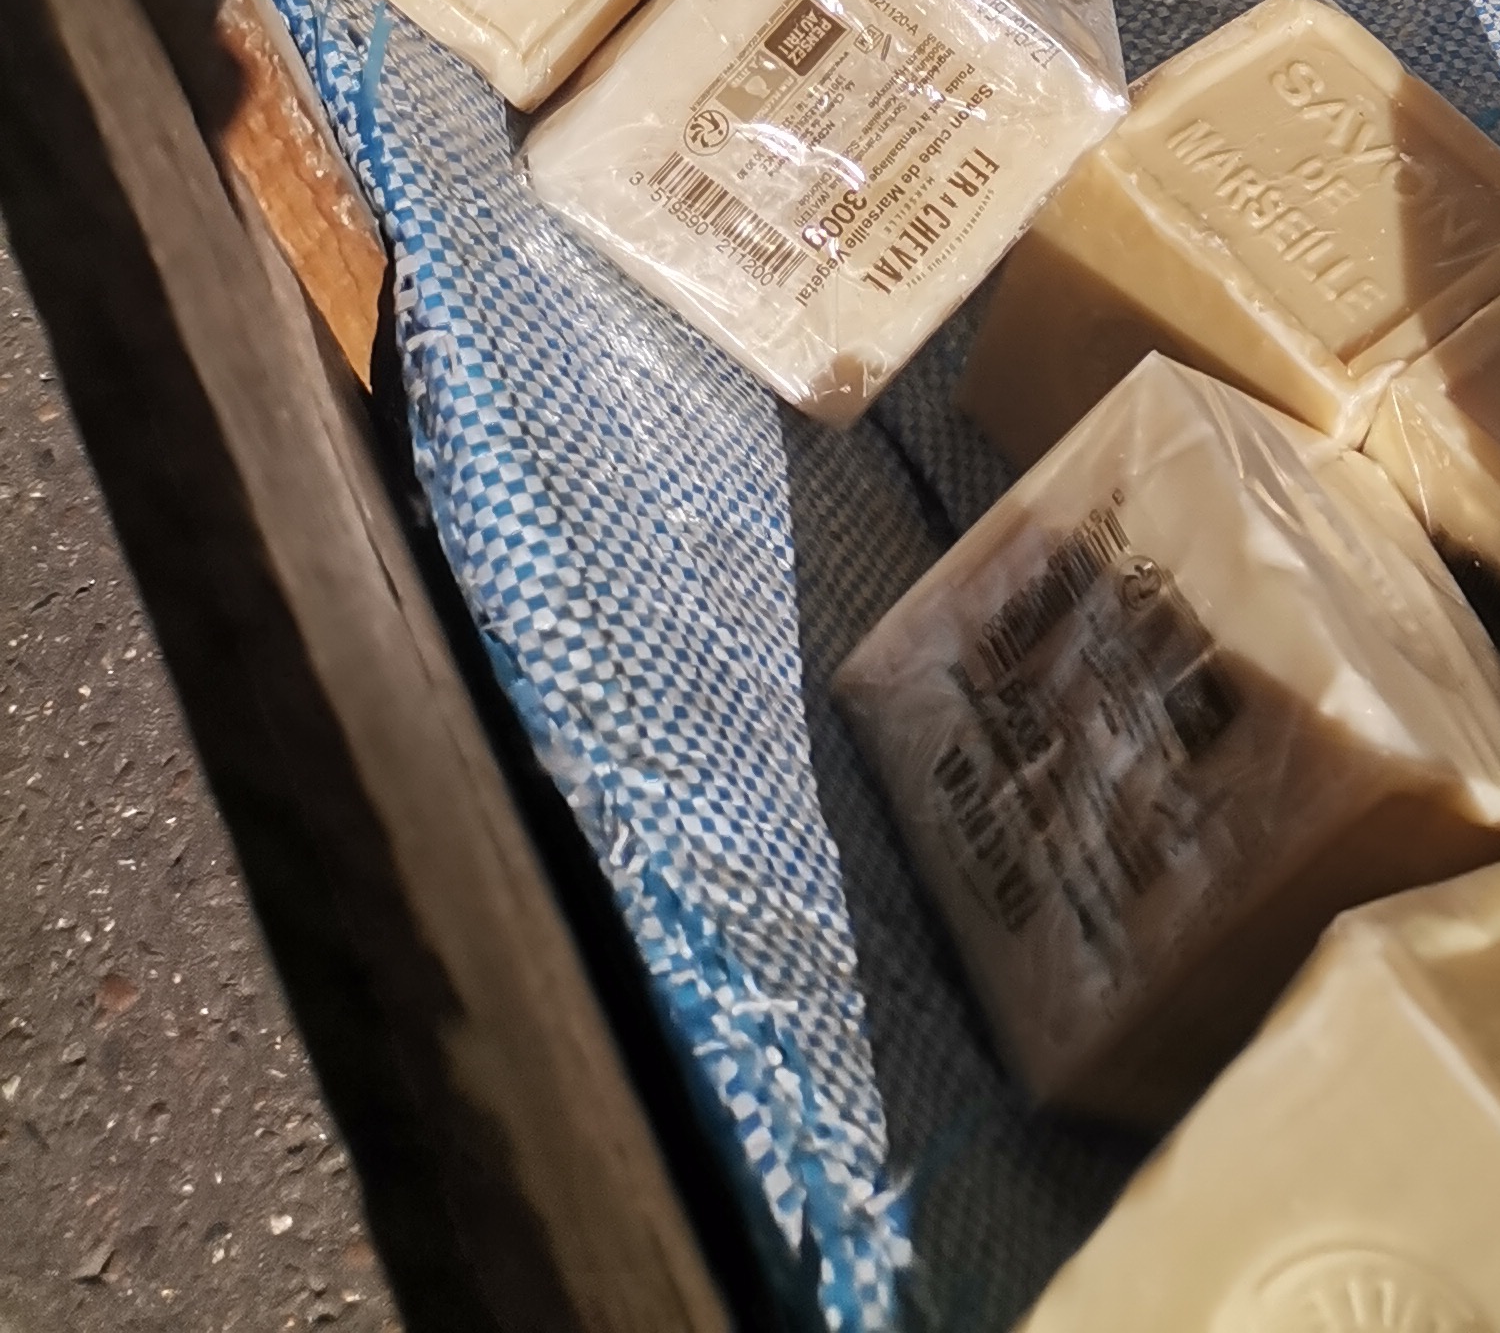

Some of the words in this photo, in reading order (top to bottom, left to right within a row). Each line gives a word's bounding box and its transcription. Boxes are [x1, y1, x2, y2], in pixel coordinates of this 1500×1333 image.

[786, 16, 833, 67] PENSEZ
[798, 8, 821, 31] AU
[943, 62, 975, 96] Poids
[947, 81, 994, 132] Savon
[920, 111, 932, 123] à
[865, 118, 925, 184] l'emballage
[899, 162, 924, 188] de
[916, 126, 955, 167] cube
[945, 145, 1001, 202] FER
[1272, 61, 1468, 241] SAVON
[793, 188, 831, 230] (WATER)
[881, 175, 935, 235] MARSEILLE
[1294, 157, 1359, 215] DE
[627, 169, 645, 188] 3
[648, 182, 710, 240] 519590
[713, 232, 776, 291] 211200
[800, 182, 870, 256] 300g
[842, 182, 906, 253] Marseille
[1166, 119, 1387, 322] MARSEILLE
[791, 243, 851, 308] Végétal
[859, 200, 953, 300] CHEVAL
